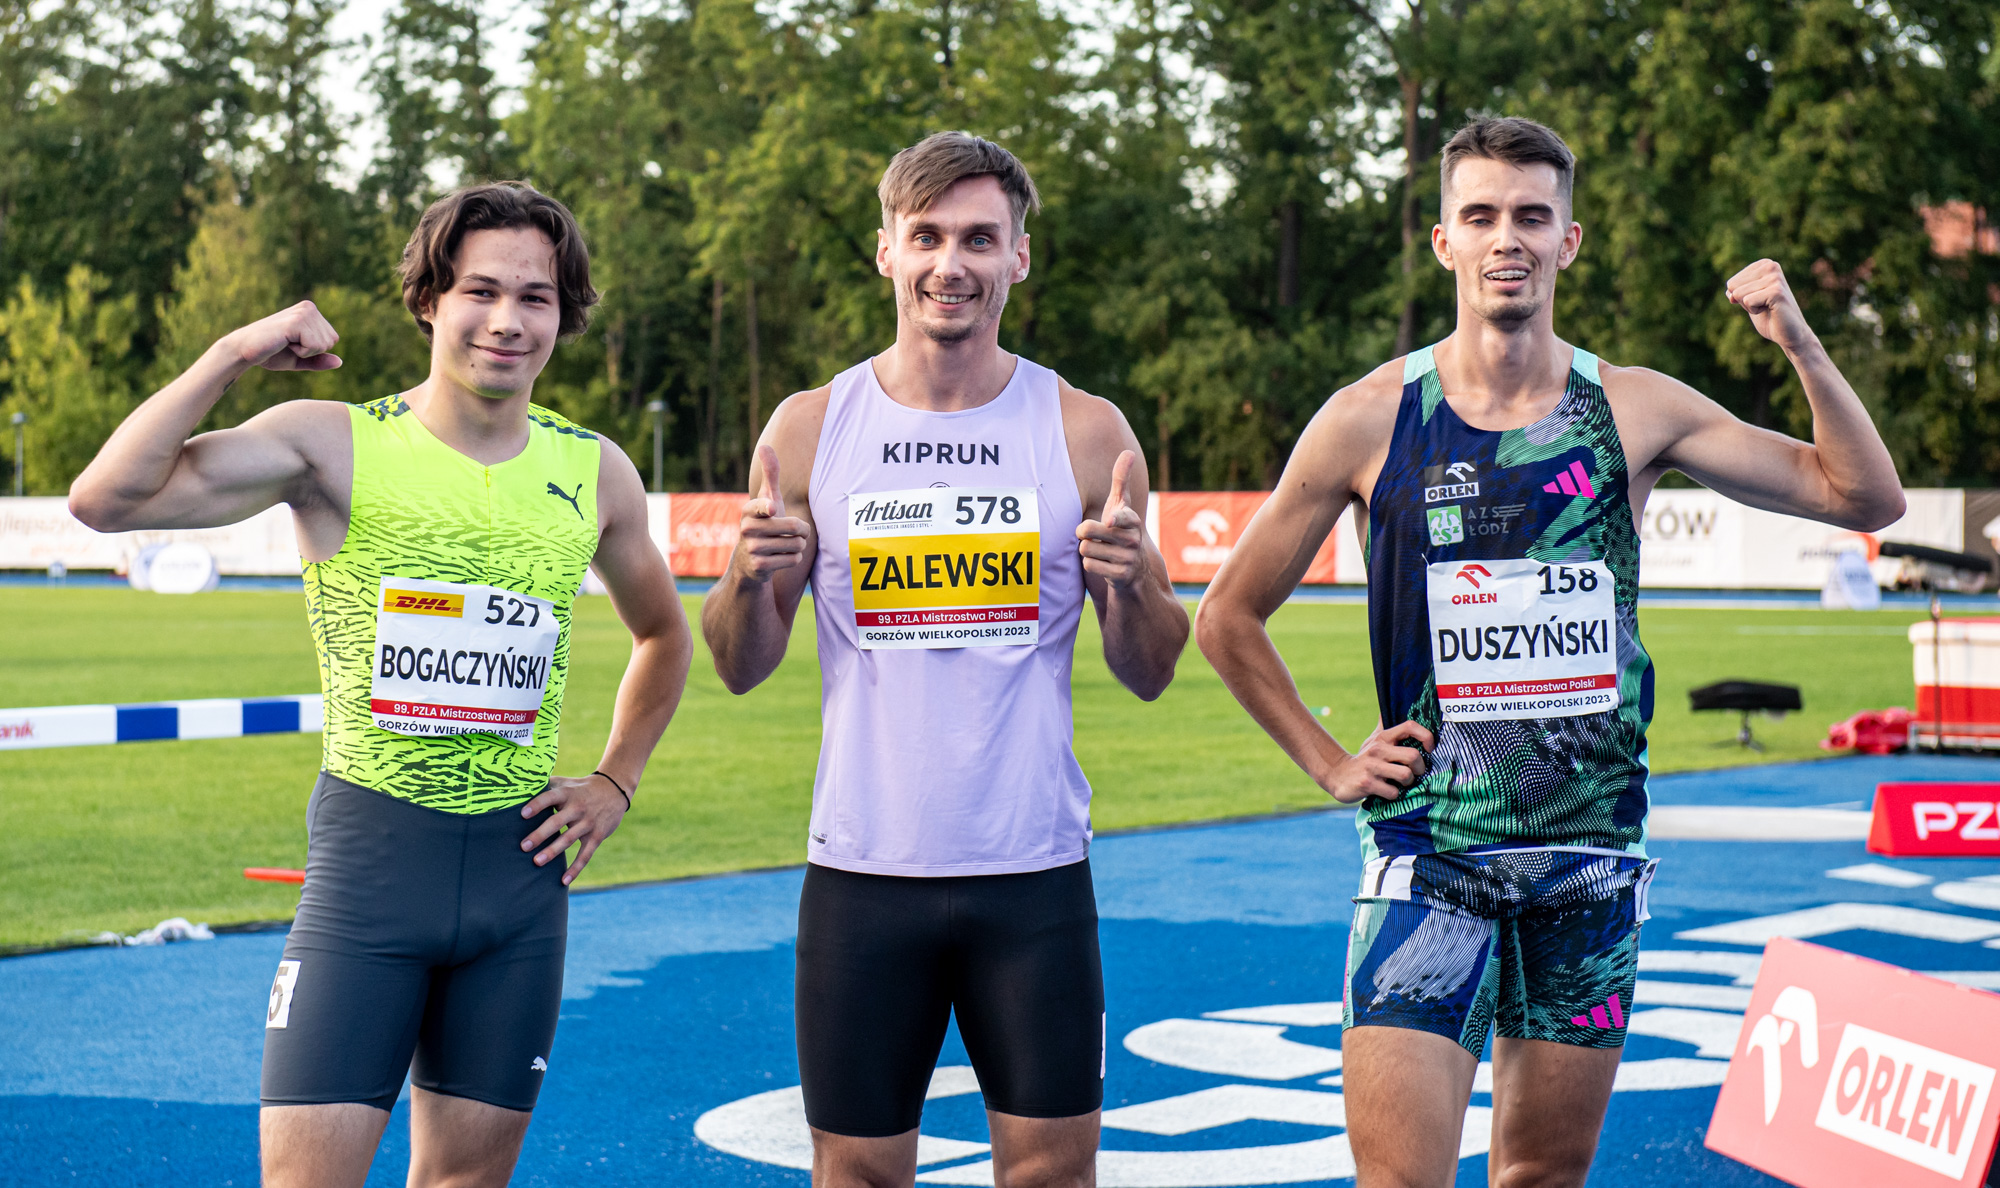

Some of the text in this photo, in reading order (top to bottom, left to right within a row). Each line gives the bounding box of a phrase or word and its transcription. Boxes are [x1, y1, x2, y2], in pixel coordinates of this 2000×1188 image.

[882, 442, 999, 466] KIPRUN
[1427, 484, 1476, 500] ORLEN
[854, 496, 1021, 526] Artisan 578
[858, 551, 1034, 591] ZALEWSKI
[1536, 565, 1599, 595] 158
[394, 594, 541, 628] DHL 527
[1451, 593, 1498, 605] ORLEN
[877, 609, 1017, 624] 99. PZLA Mistrzostwa Polski
[865, 626, 1030, 641] GORZÓW WIELKOPOLSKI 2023
[1437, 615, 1608, 663] DUSZYŃSKI
[380, 644, 547, 689] BOGACZYŃSKI
[1457, 678, 1596, 696] 99. PZLA Mistrzostwa Polski
[394, 703, 527, 723] 99. PZLA Mistrzostwa Polski
[1445, 694, 1611, 713] GORZÓW WIELKOPOLSKI 2023
[378, 719, 431, 733] GORZÓW
[514, 728, 529, 739] 2023
[1912, 801, 2000, 841] PZ
[268, 966, 290, 1022] 5
[1835, 1046, 1977, 1156] ORLEN
